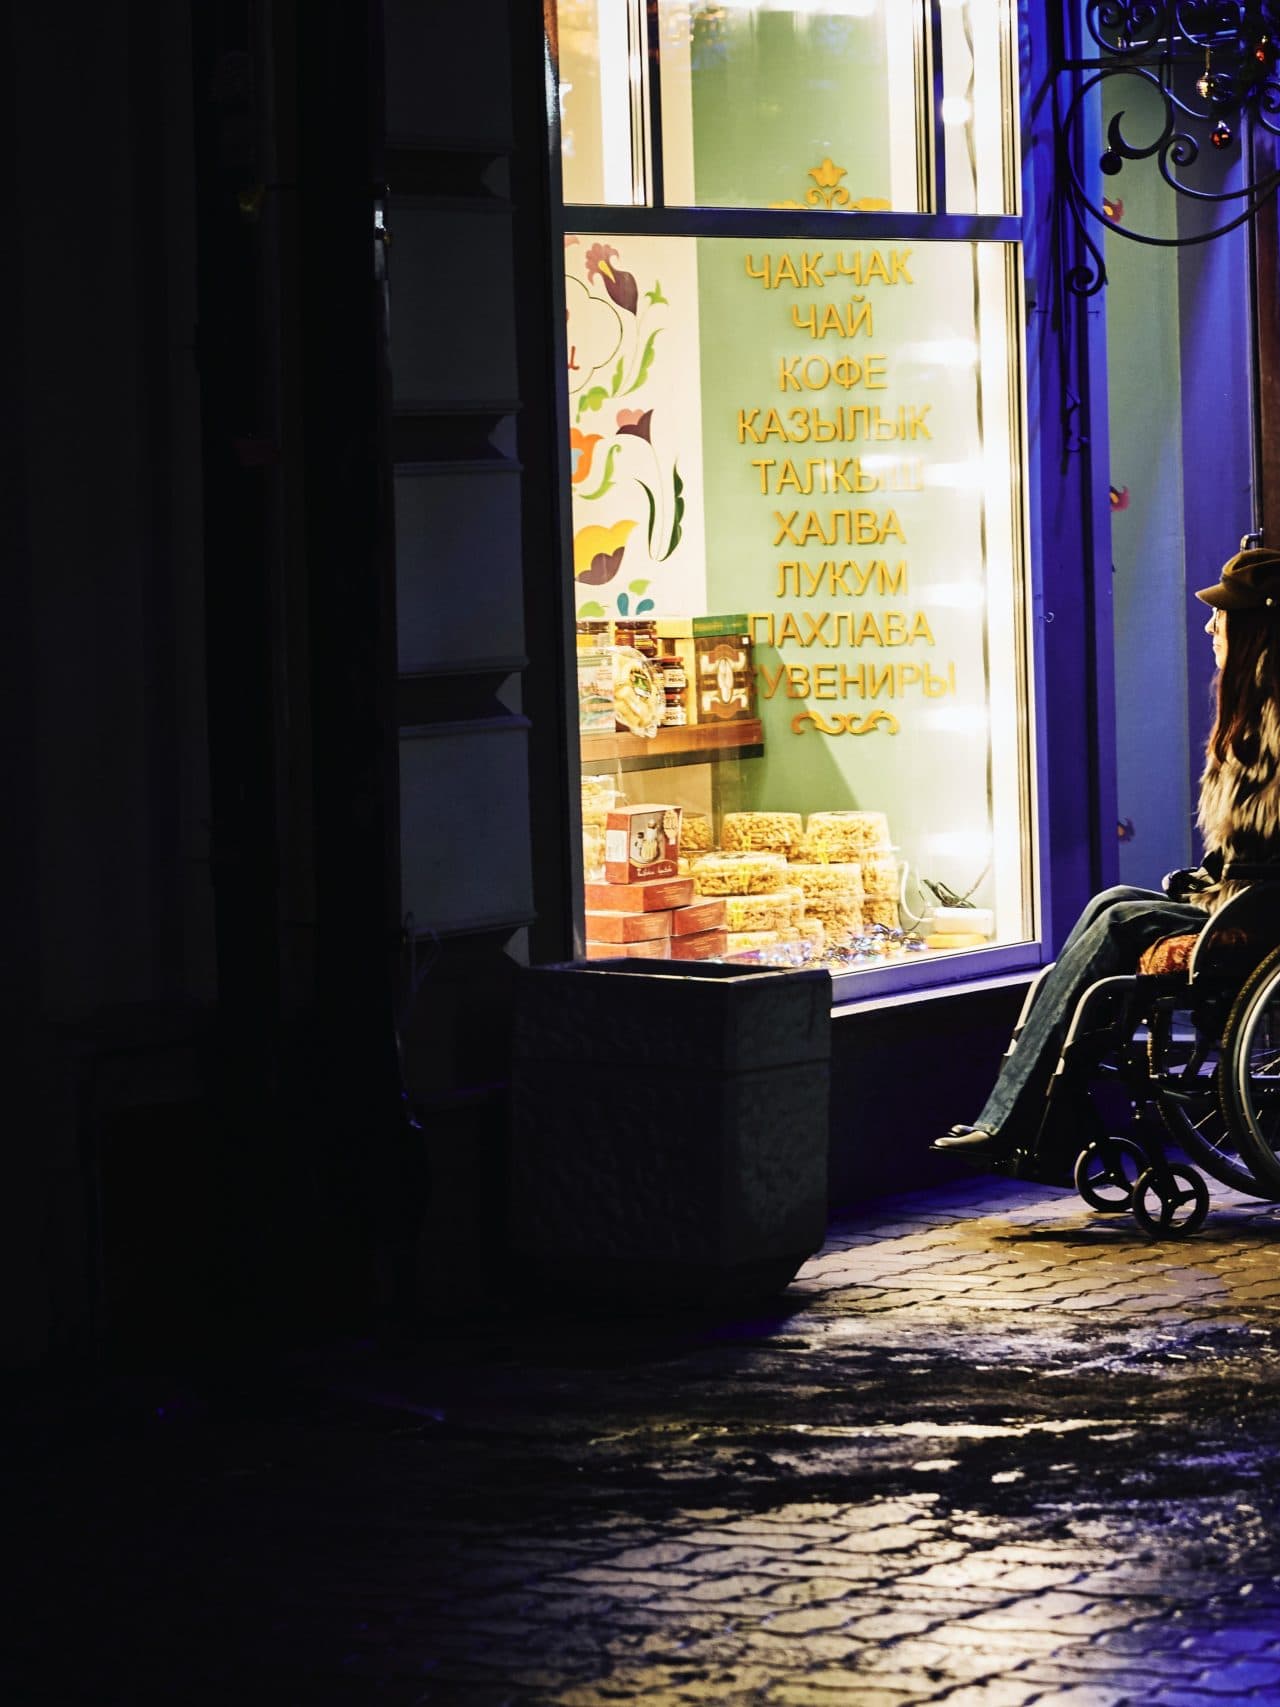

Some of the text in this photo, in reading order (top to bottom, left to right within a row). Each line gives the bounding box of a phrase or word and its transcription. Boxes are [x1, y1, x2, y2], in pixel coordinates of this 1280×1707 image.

[744, 248, 914, 289] ЧАК-ЧАК
[792, 295, 873, 339] ЧАЙ
[778, 354, 888, 392] КОФЕ
[737, 404, 933, 444] КАЗЫЛЫК
[773, 509, 906, 546] ХАЛВА
[776, 560, 908, 598] ЛУКУМ
[748, 612, 934, 648] ПАХЛАВА
[752, 662, 956, 700] УВЕНИРЫ
